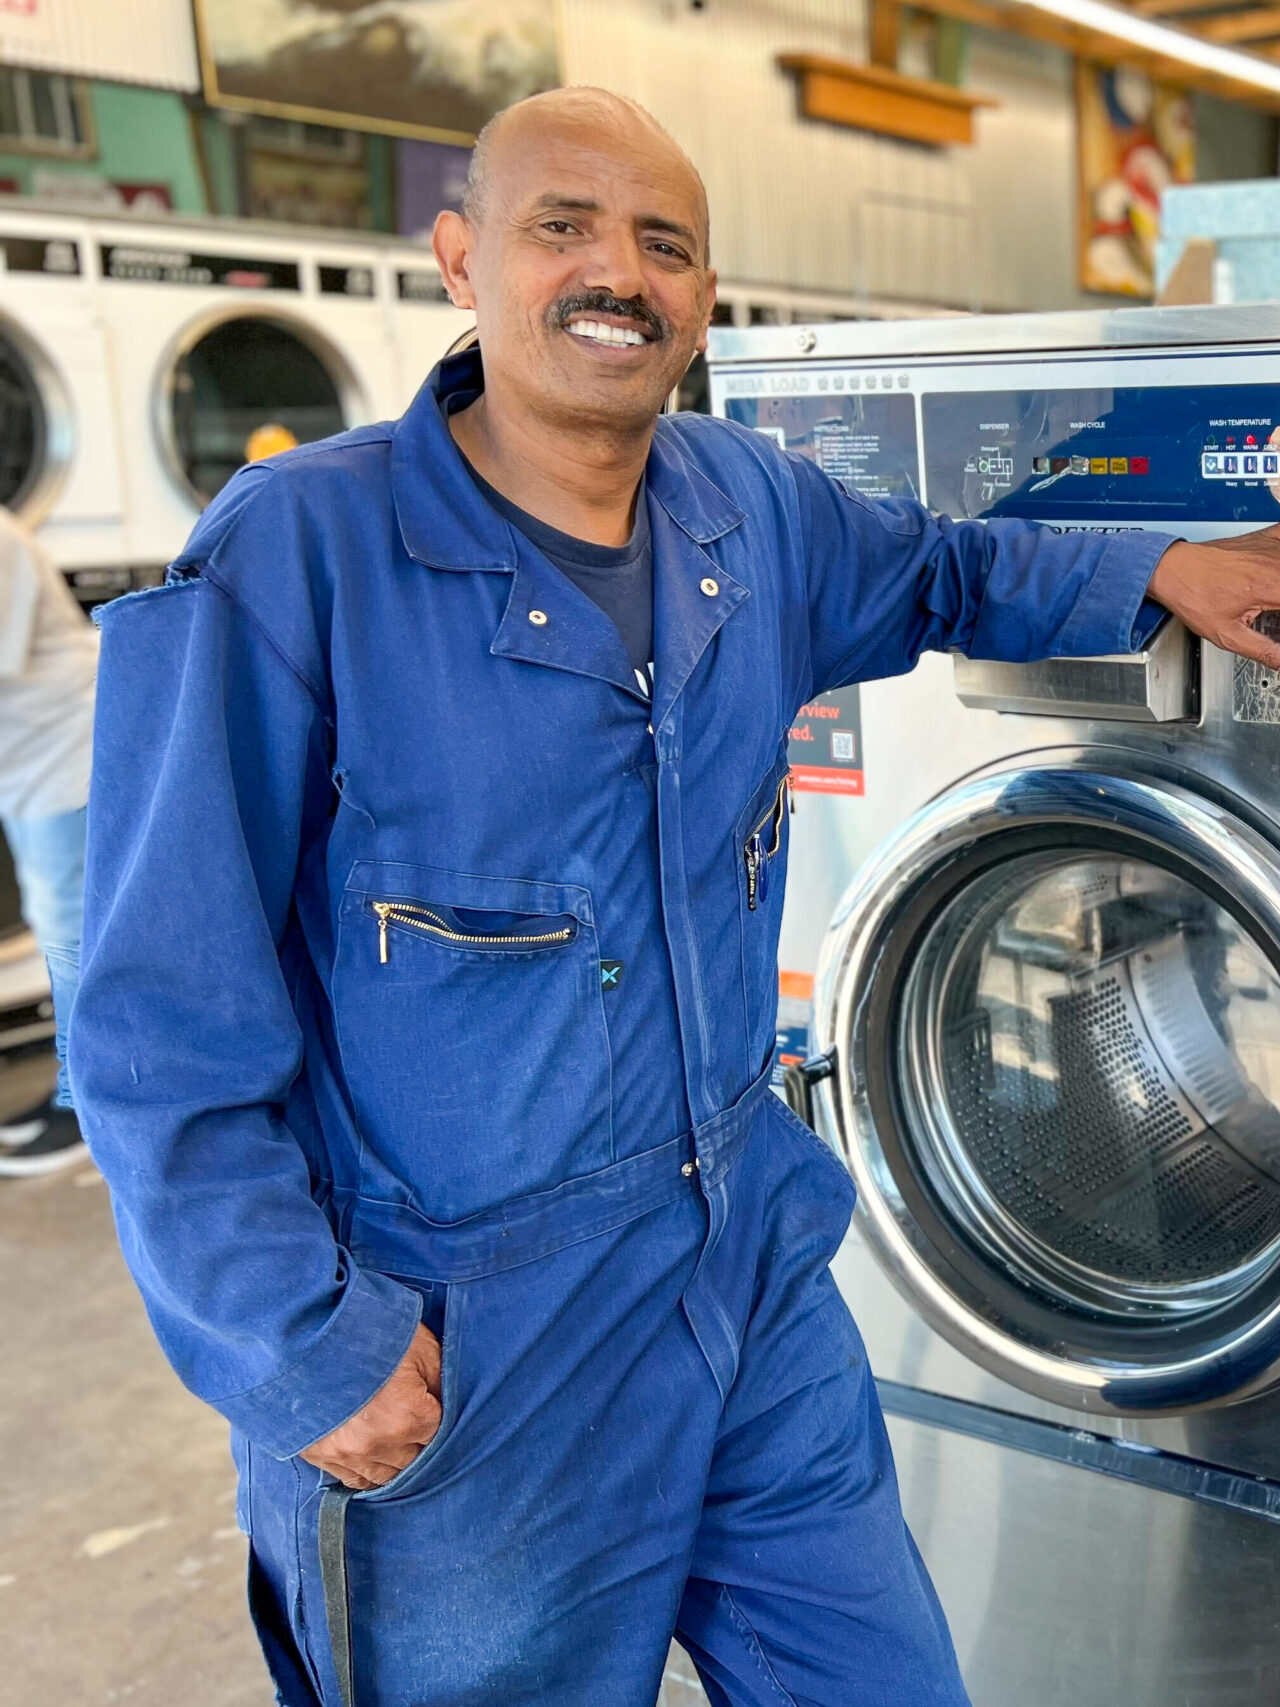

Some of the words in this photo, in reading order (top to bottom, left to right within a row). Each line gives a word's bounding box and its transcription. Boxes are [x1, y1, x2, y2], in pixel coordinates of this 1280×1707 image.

[726, 377, 764, 393] MEGA
[770, 377, 809, 392] LOAD
[798, 701, 840, 719] rview
